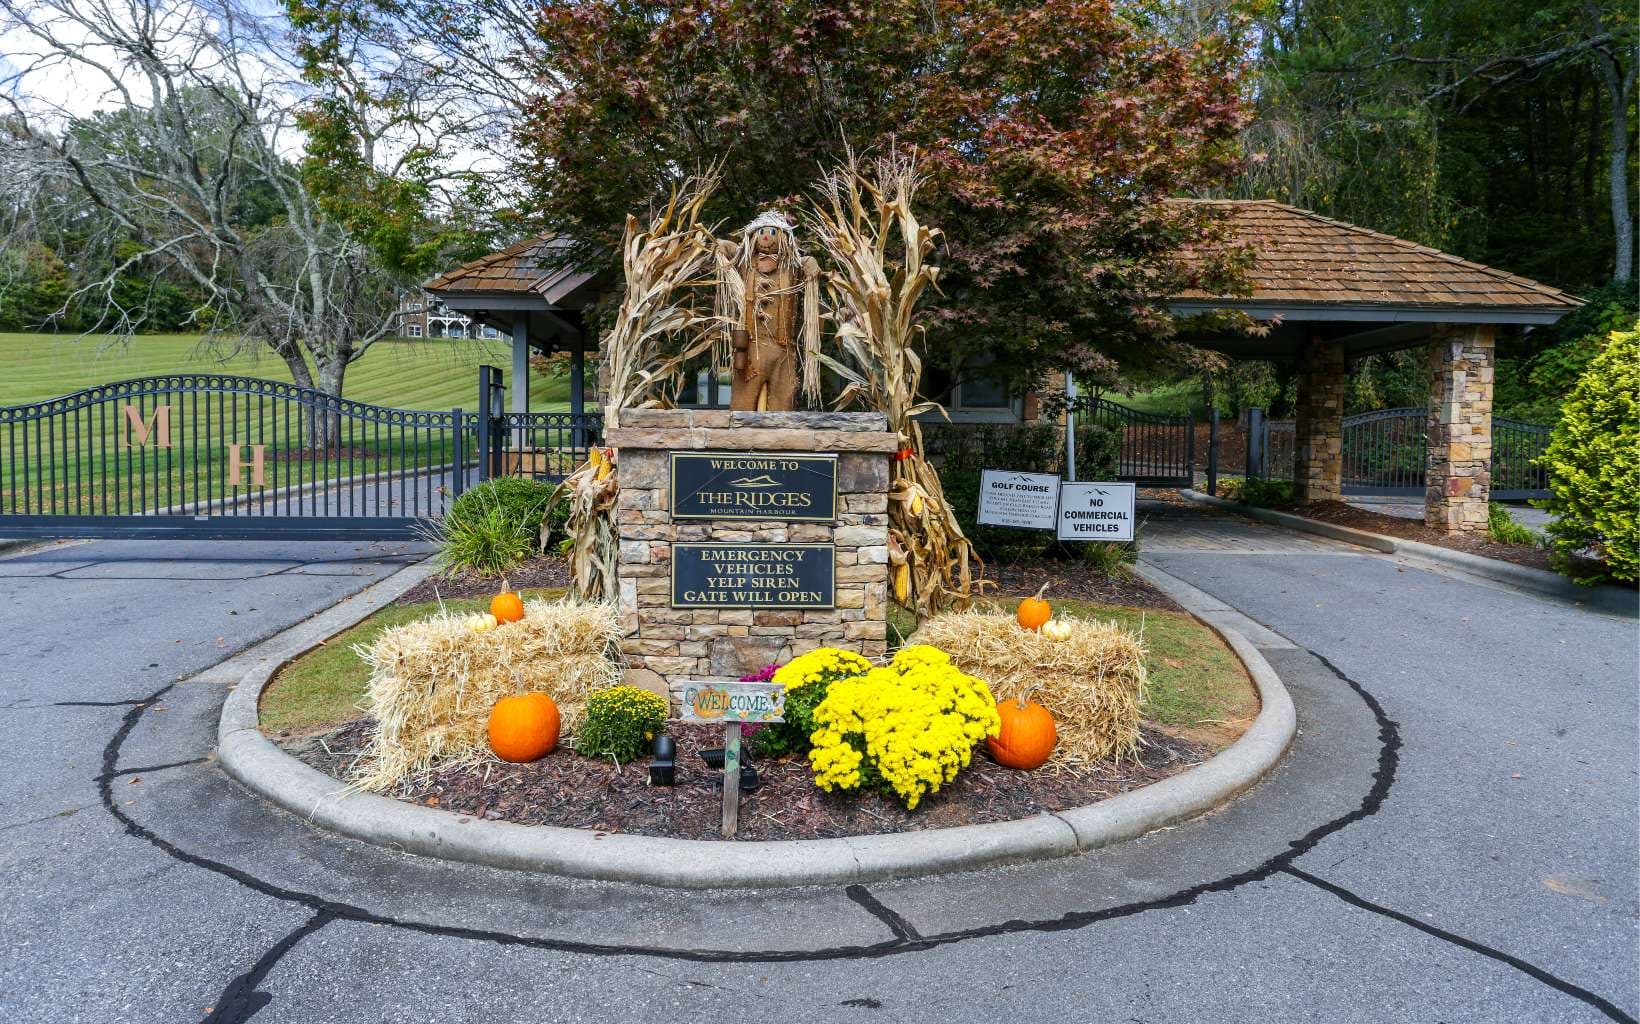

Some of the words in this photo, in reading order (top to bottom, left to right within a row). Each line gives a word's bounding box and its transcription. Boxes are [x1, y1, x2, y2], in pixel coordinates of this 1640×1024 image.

[123, 405, 174, 448] M
[228, 444, 267, 486] H
[711, 459, 777, 470] WELCOME
[780, 460, 799, 471] TO
[991, 482, 1014, 490] GOLF
[1015, 484, 1049, 493] COURSE
[696, 491, 733, 504] THE
[736, 491, 811, 509] RIDGES
[1089, 498, 1104, 507] NO
[1064, 510, 1129, 520] COMMERCIAL
[1073, 523, 1120, 532] VEHICLES
[701, 550, 806, 562] EMERGENCY
[713, 563, 794, 575] VEHICLES
[707, 577, 747, 588] YELP
[751, 577, 800, 589] SIREN
[684, 590, 729, 602] GATE
[732, 591, 774, 602] WILL
[778, 591, 823, 602] OPEN
[697, 691, 769, 711] WELCOME
